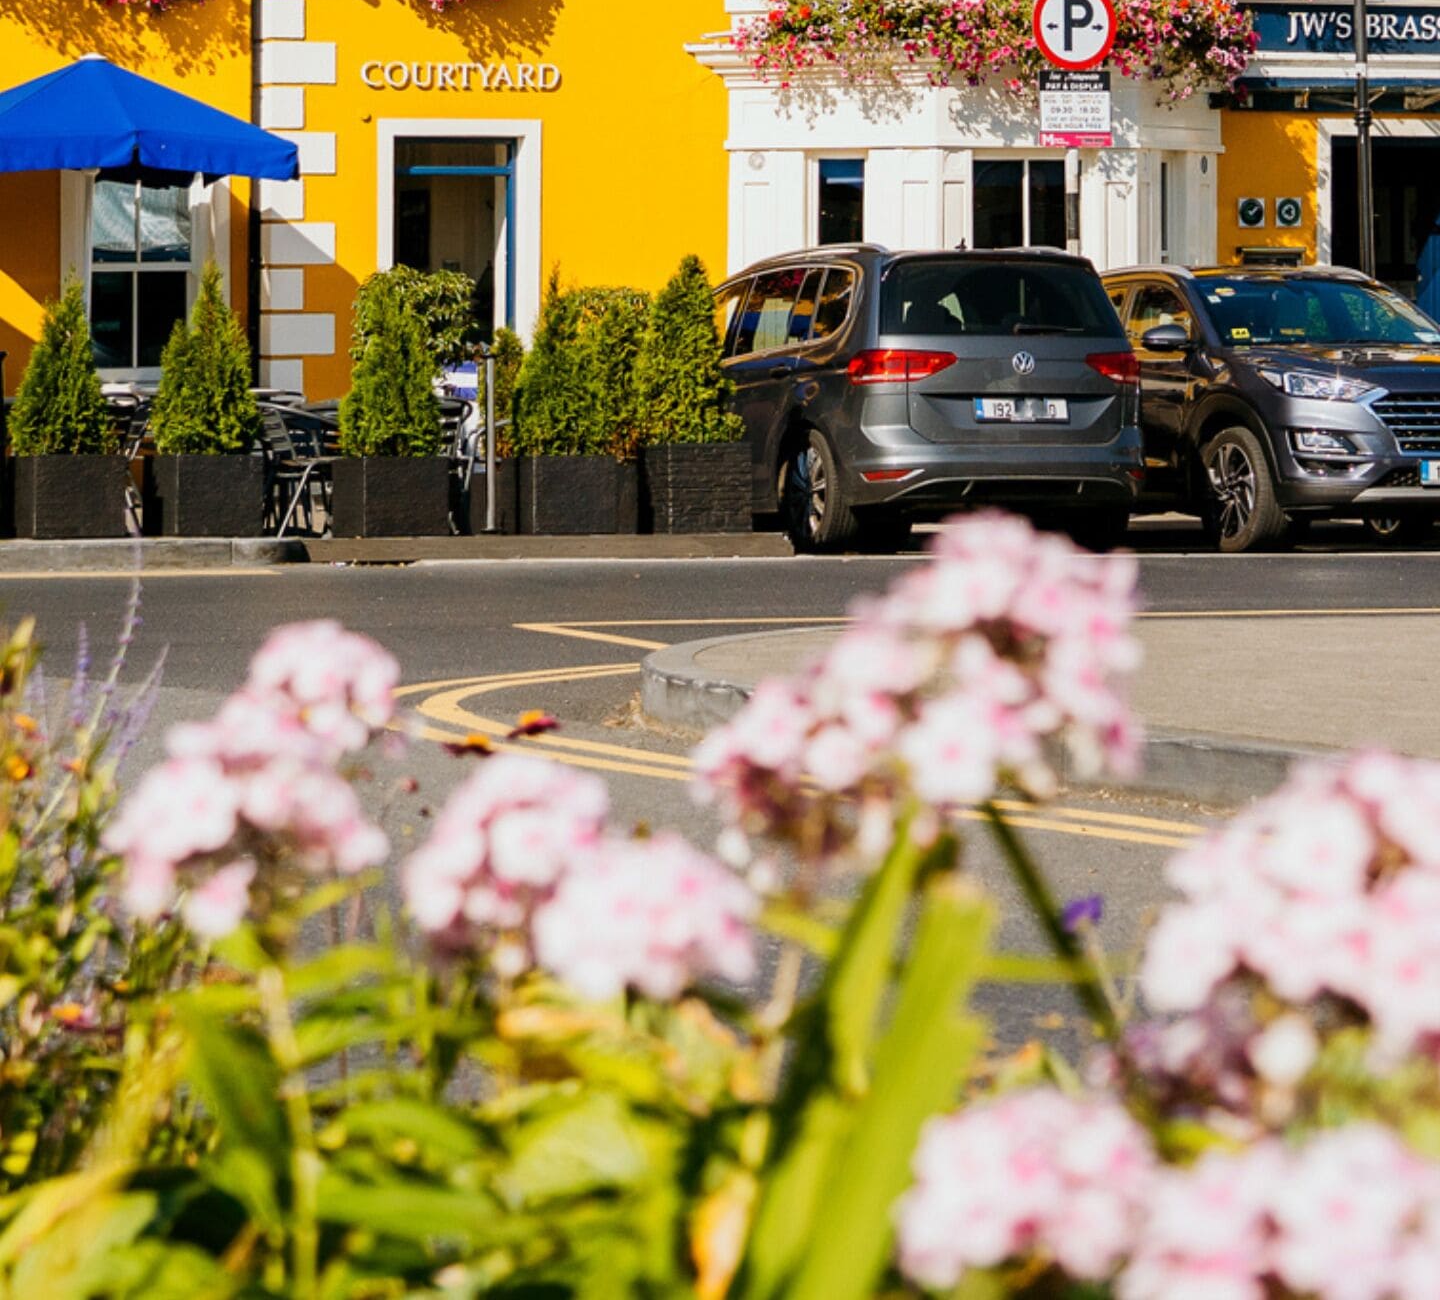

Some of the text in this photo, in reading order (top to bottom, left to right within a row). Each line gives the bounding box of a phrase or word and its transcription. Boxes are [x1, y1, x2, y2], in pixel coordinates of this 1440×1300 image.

[1287, 11, 1351, 43] JW'S
[360, 59, 562, 92] COURTYARD
[1045, 82, 1061, 90] PAY
[1069, 82, 1104, 90] DISPLAY
